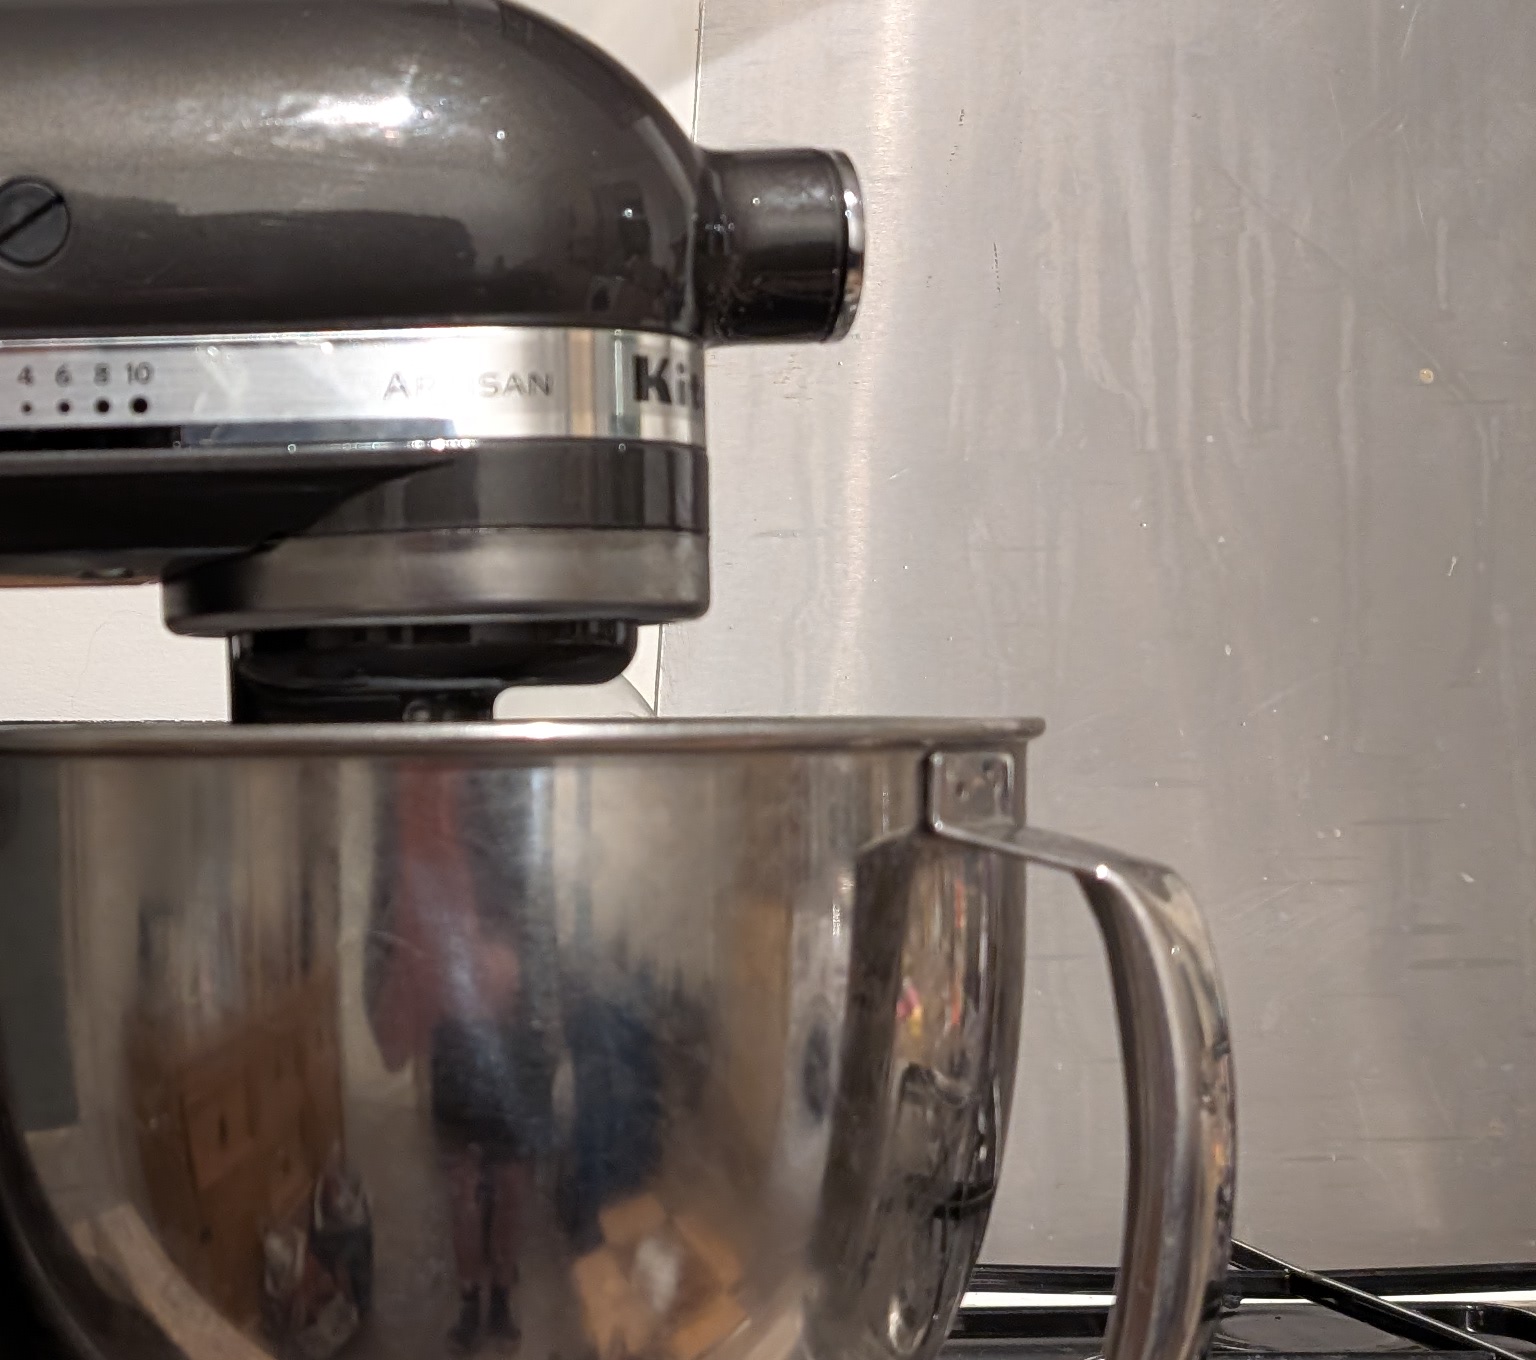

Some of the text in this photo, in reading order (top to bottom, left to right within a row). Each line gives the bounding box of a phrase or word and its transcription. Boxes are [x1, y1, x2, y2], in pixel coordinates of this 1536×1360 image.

[18, 365, 34, 386] 4
[55, 364, 72, 388] 6
[93, 362, 110, 386] 8
[126, 361, 154, 385] 10
